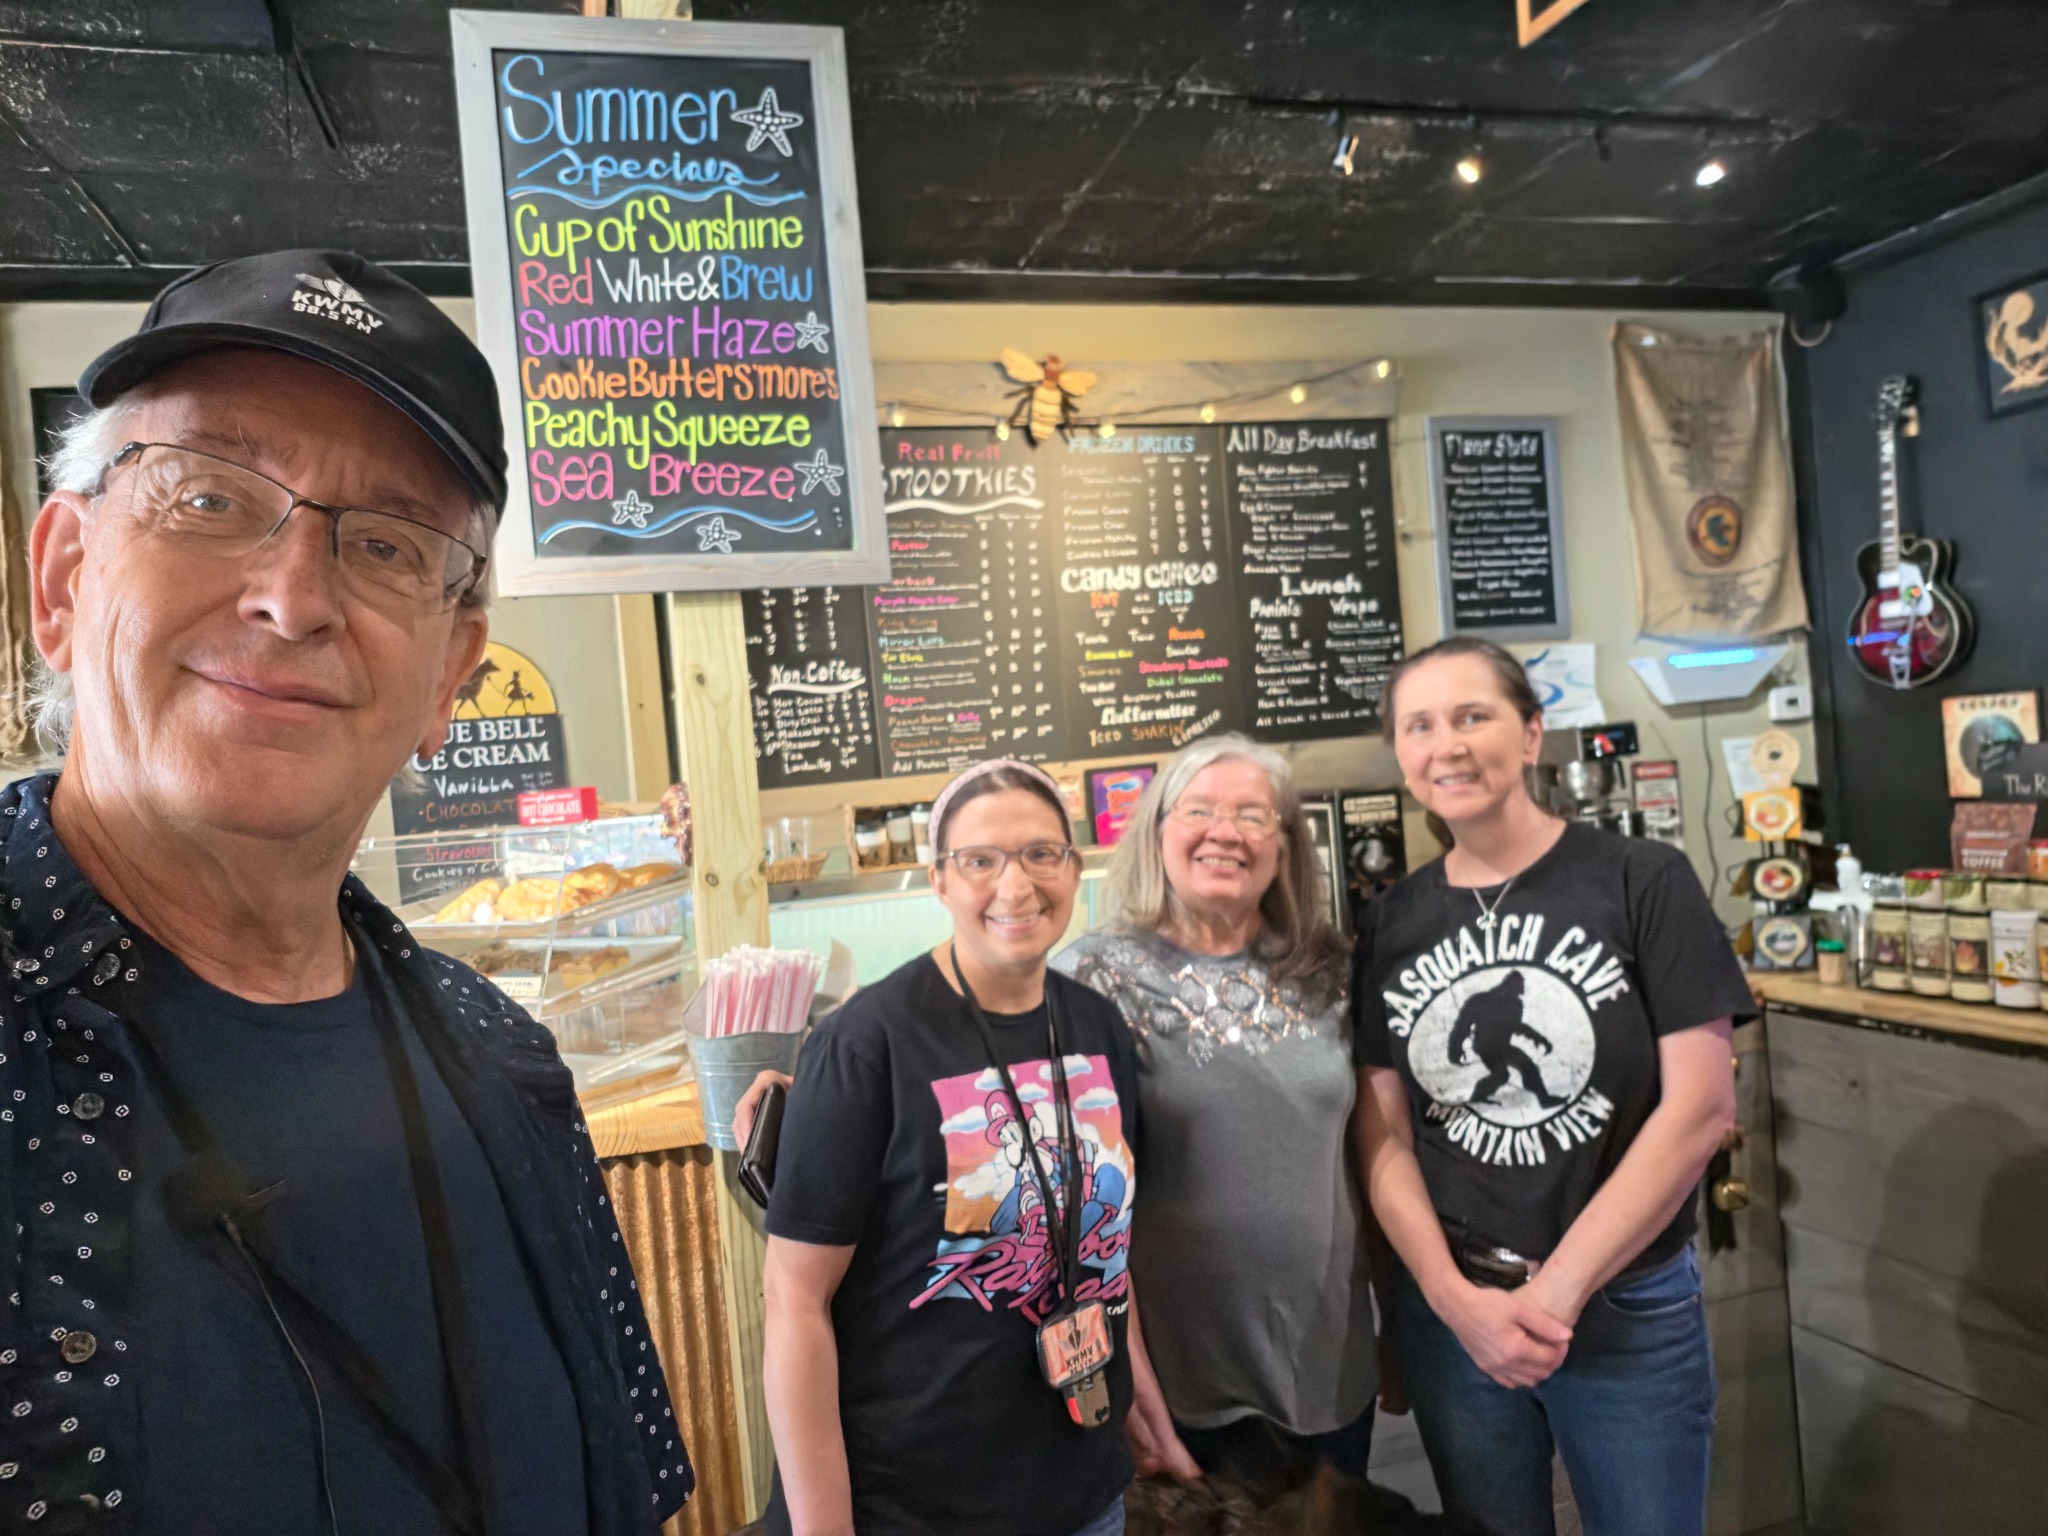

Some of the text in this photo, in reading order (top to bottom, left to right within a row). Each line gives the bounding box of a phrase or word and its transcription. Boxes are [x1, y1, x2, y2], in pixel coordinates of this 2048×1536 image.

[502, 56, 736, 145] Summer
[514, 194, 803, 274] Cup of Sunshine
[519, 257, 593, 305] Red
[720, 255, 812, 301] Brew
[292, 290, 383, 328] KWMV
[345, 316, 371, 335] FM
[520, 305, 796, 359] Summer Haze
[521, 357, 627, 401] Cookie
[527, 400, 811, 470] Peachy Squeeze
[1138, 436, 1195, 453] DRINKS
[1226, 427, 1377, 455] All Day Breakfast
[898, 442, 945, 461] Real
[530, 450, 796, 507] Sea Breeze
[1061, 561, 1217, 592] candy coffee
[1280, 573, 1362, 597] Lunch
[1330, 596, 1379, 620] Wraps
[770, 660, 862, 684] Non-Coffee
[444, 718, 546, 744] UE BELL
[413, 742, 551, 772] CE CREAM
[426, 799, 517, 823] CHOCOLAT
[1963, 858, 2004, 868] COFFEE
[1383, 914, 1629, 1038] SASQUATCH CAVE
[1426, 1086, 1615, 1167] MOUNTAIN VIEW
[1066, 1345, 1093, 1368] KWMV
